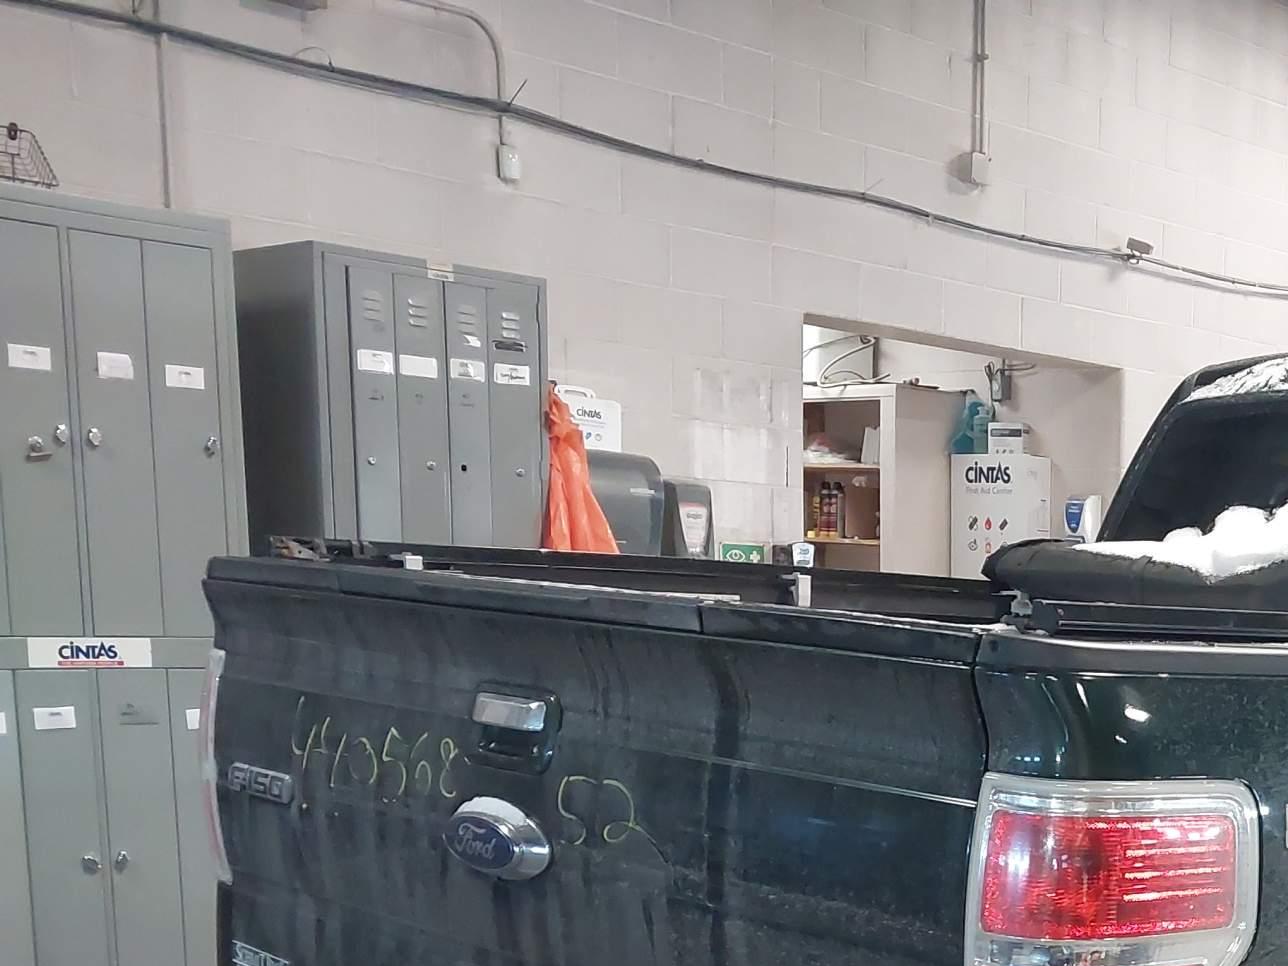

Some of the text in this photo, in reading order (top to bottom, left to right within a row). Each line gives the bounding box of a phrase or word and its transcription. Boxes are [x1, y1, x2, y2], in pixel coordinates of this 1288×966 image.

[964, 461, 1012, 484] CINTAS
[58, 640, 118, 659] CINTAS
[455, 821, 499, 860] Ford
